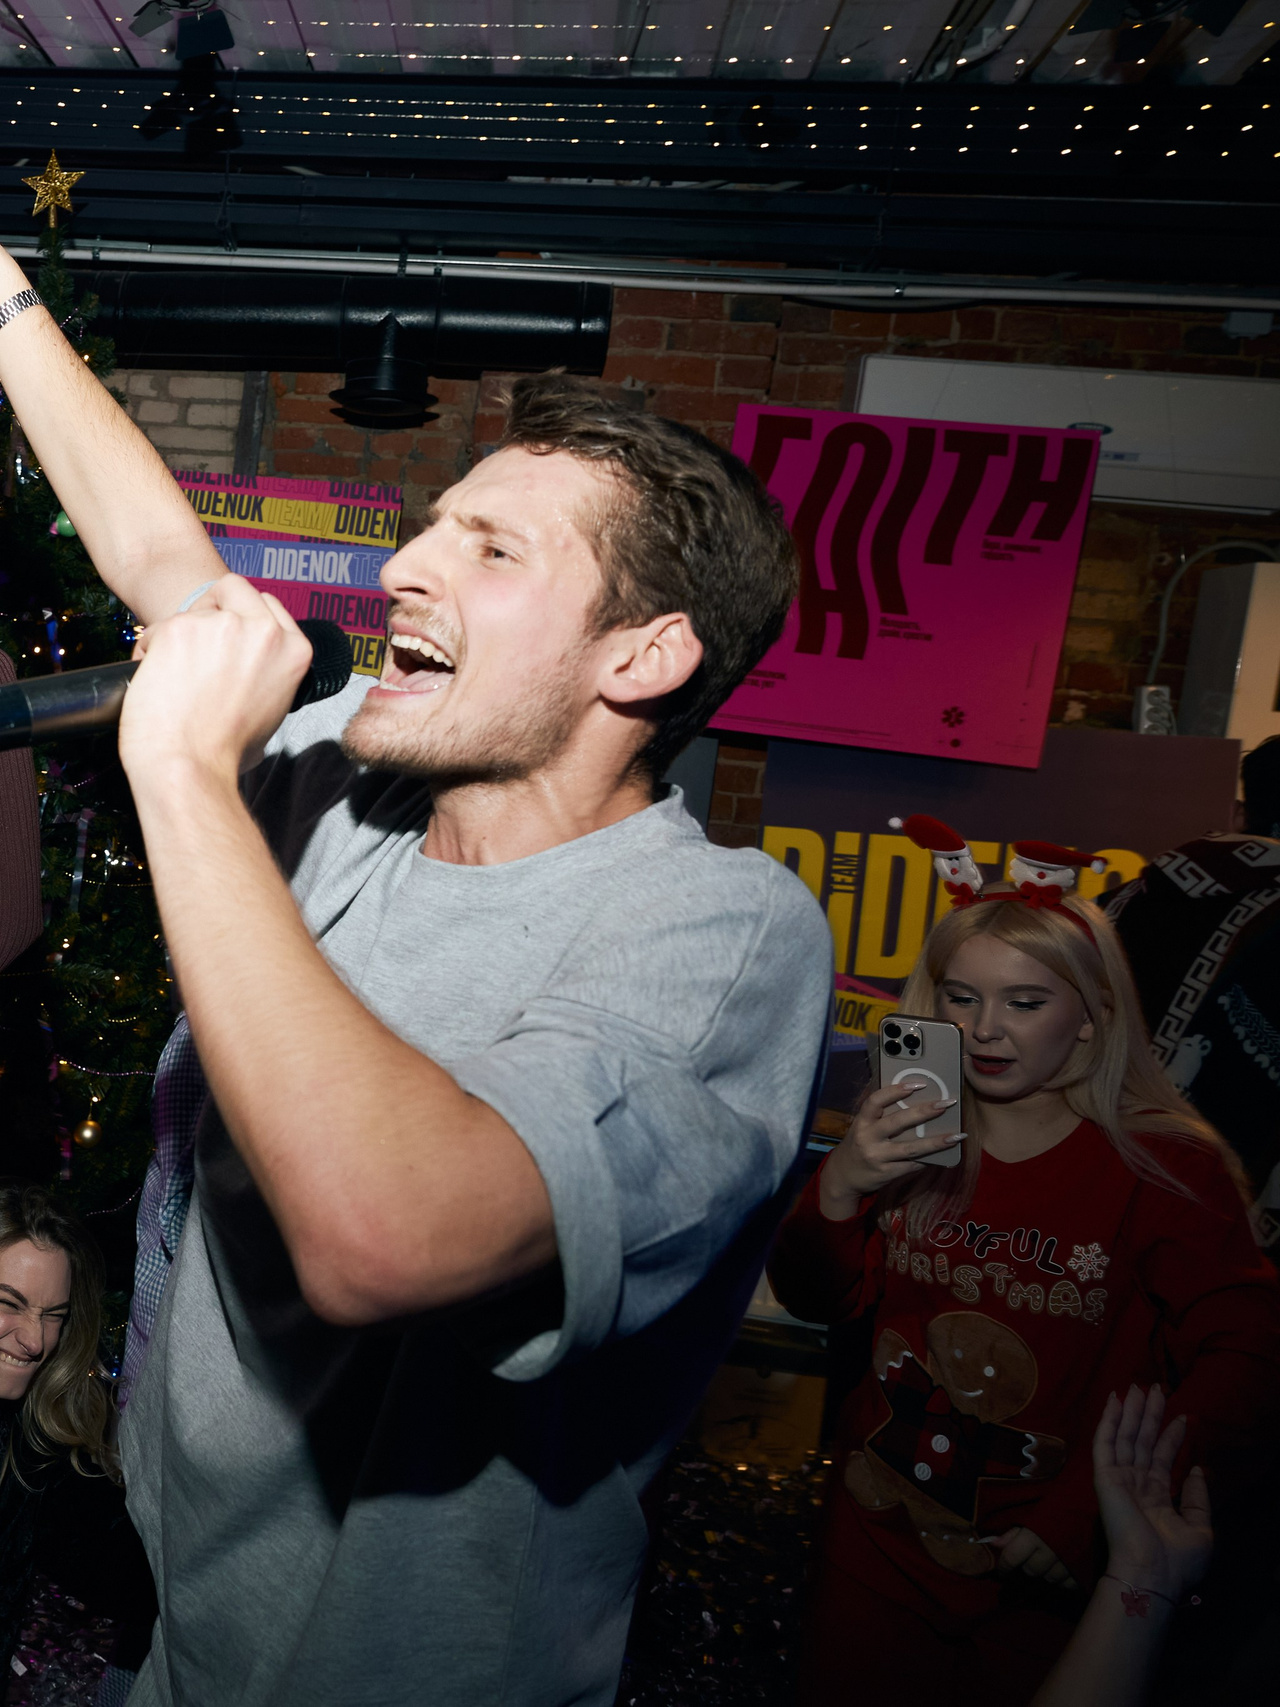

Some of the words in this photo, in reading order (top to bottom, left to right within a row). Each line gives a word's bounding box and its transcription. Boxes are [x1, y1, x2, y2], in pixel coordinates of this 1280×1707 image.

[261, 547, 353, 585] DIDENOK
[307, 590, 388, 631] DIDENO
[829, 854, 861, 894] TEAM
